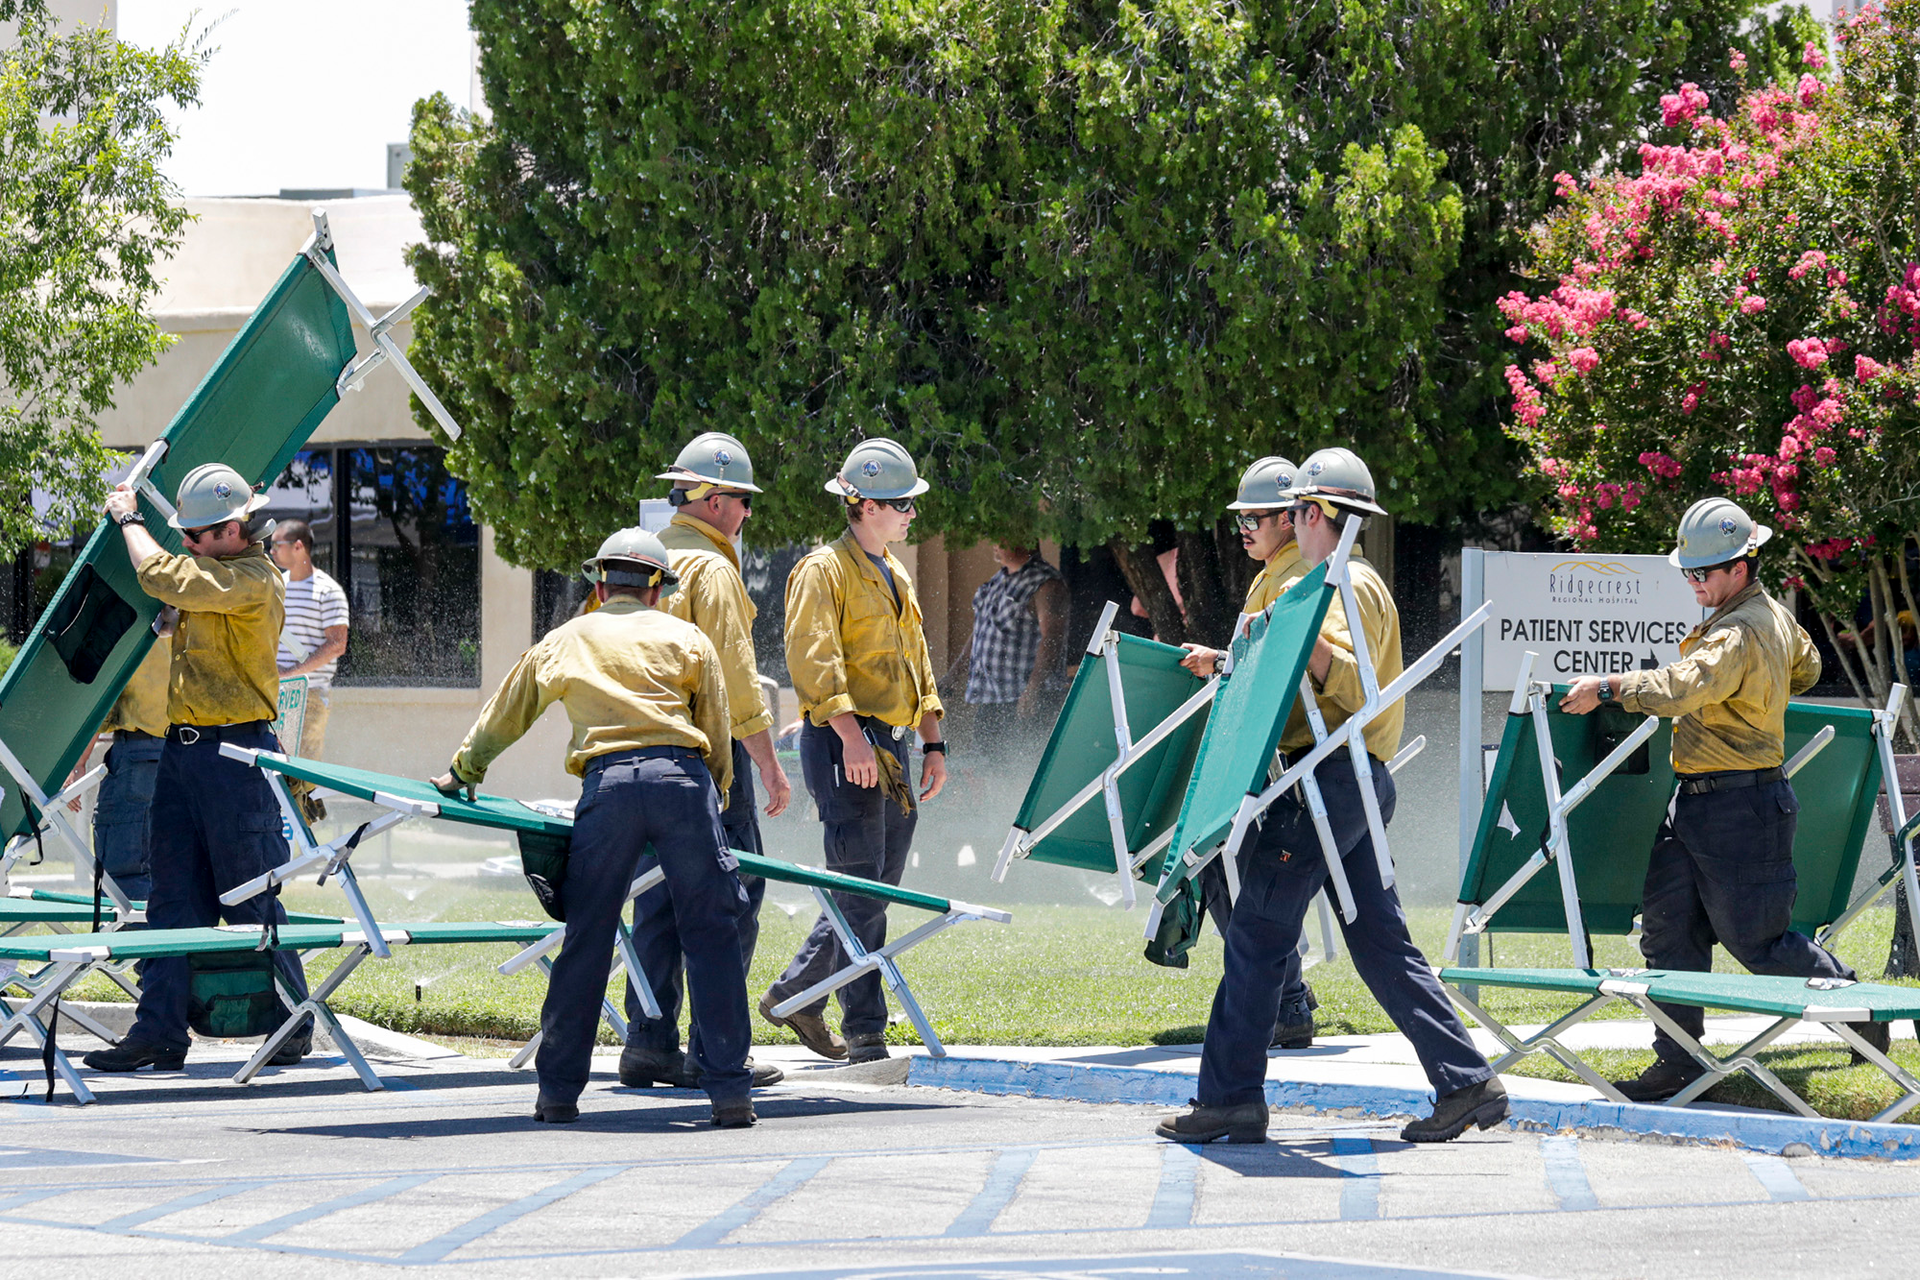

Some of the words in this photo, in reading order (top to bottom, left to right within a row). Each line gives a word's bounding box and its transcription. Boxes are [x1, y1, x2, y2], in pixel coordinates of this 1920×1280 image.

[1549, 573, 1640, 597] Ridgecrest
[1551, 596, 1593, 604] REGIONAL
[1598, 597, 1638, 605] HOSPITAL
[1500, 618, 1583, 642] PATIENT
[1588, 620, 1687, 644] SERVICES
[1554, 650, 1634, 673] CENTER
